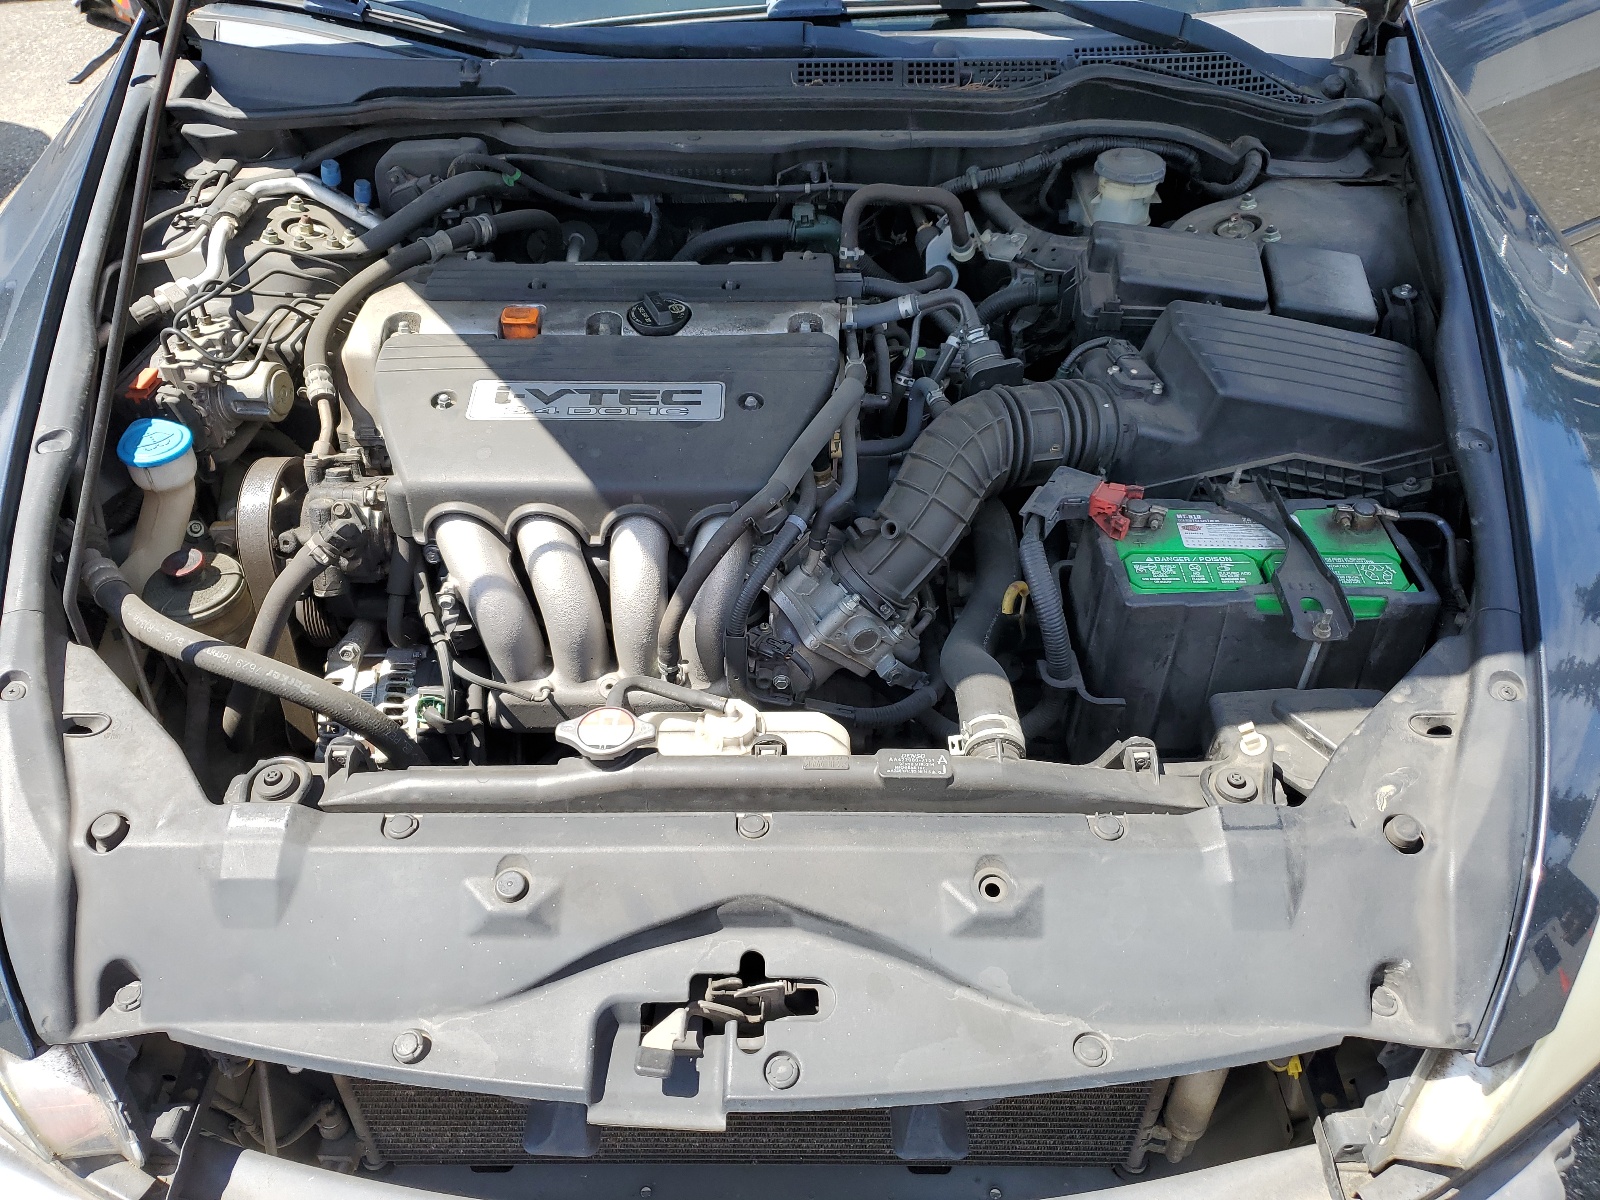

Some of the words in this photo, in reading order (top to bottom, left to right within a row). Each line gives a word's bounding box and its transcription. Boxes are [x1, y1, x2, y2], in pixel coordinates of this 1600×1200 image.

[495, 386, 702, 406] i-VTEC
[567, 406, 689, 416] DOHC
[235, 658, 263, 676] 7629
